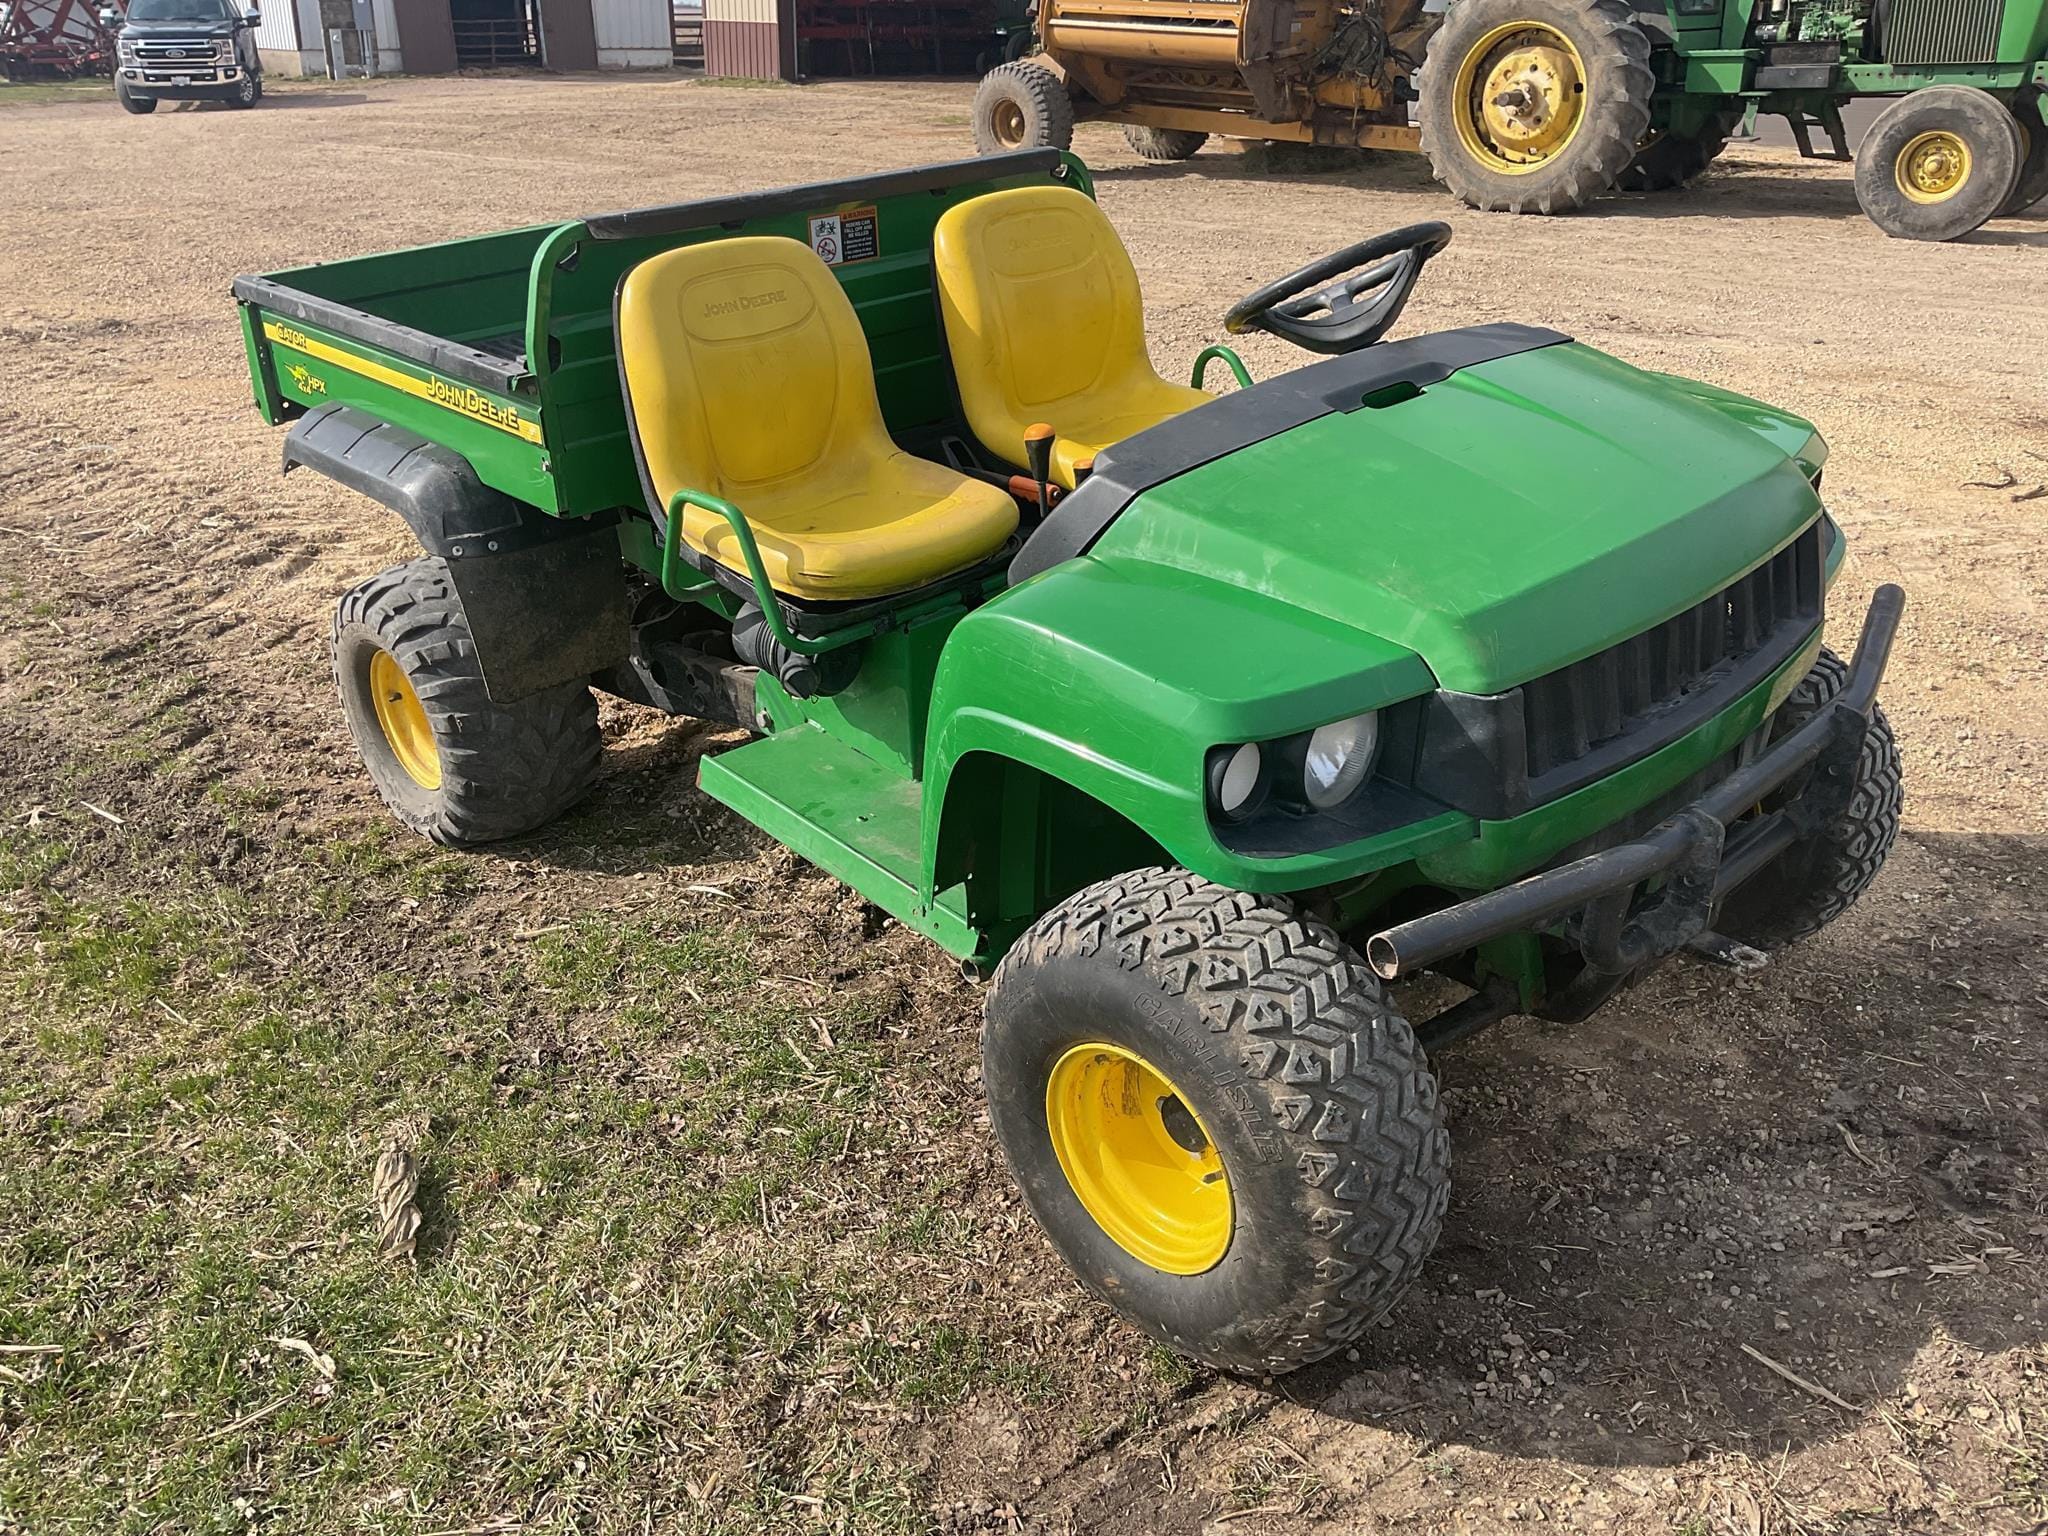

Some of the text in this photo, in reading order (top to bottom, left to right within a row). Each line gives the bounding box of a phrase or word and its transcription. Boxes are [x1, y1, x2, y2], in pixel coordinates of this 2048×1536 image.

[703, 290, 787, 318] JOHN DEERE
[275, 322, 307, 349] GATOR
[307, 375, 328, 396] HPX
[427, 375, 520, 430] JOHN DEERE
[1132, 992, 1283, 1163] CARLISLE
